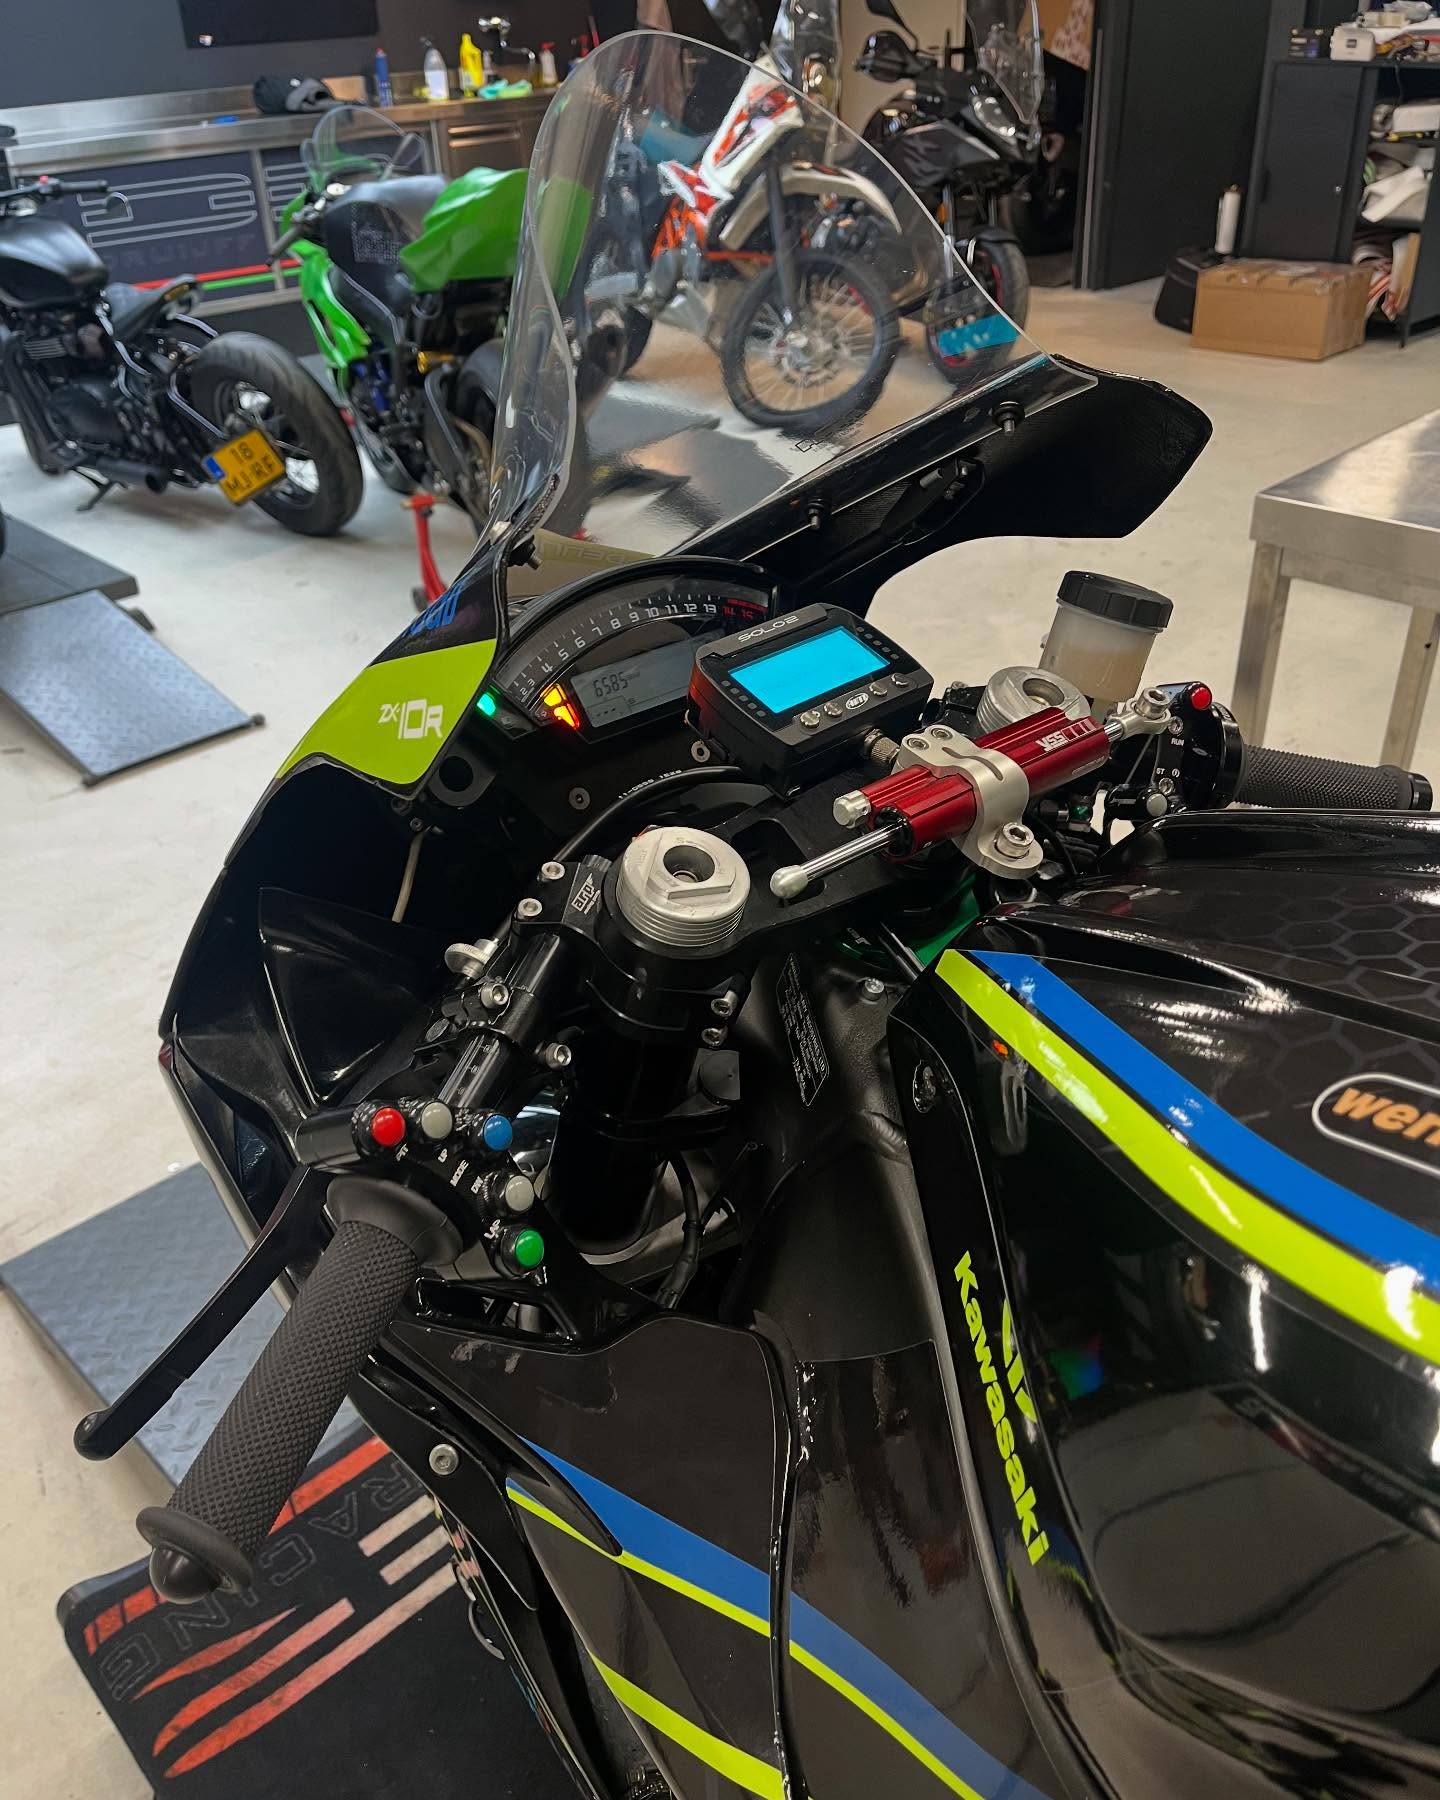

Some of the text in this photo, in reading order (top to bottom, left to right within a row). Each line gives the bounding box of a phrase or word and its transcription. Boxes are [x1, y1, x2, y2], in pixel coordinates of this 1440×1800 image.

[230, 441, 254, 465] 18
[527, 678, 535, 687] 3
[541, 662, 553, 673] 4
[558, 648, 570, 661] 5
[574, 636, 586, 649] 6
[591, 626, 603, 636] 7
[610, 618, 621, 630] 8
[628, 611, 640, 623] 9
[645, 606, 659, 618] 10
[665, 604, 679, 614] 11
[683, 603, 698, 613] 12
[703, 603, 717, 614] 13
[722, 605, 736, 617] 14
[741, 608, 753, 620] 15
[1170, 737, 1185, 748] RUN
[437, 1148, 448, 1163] UP
[450, 1159, 470, 1187] MODE
[484, 1218, 501, 1240] LAP
[954, 1250, 1050, 1566] Kawasaki
